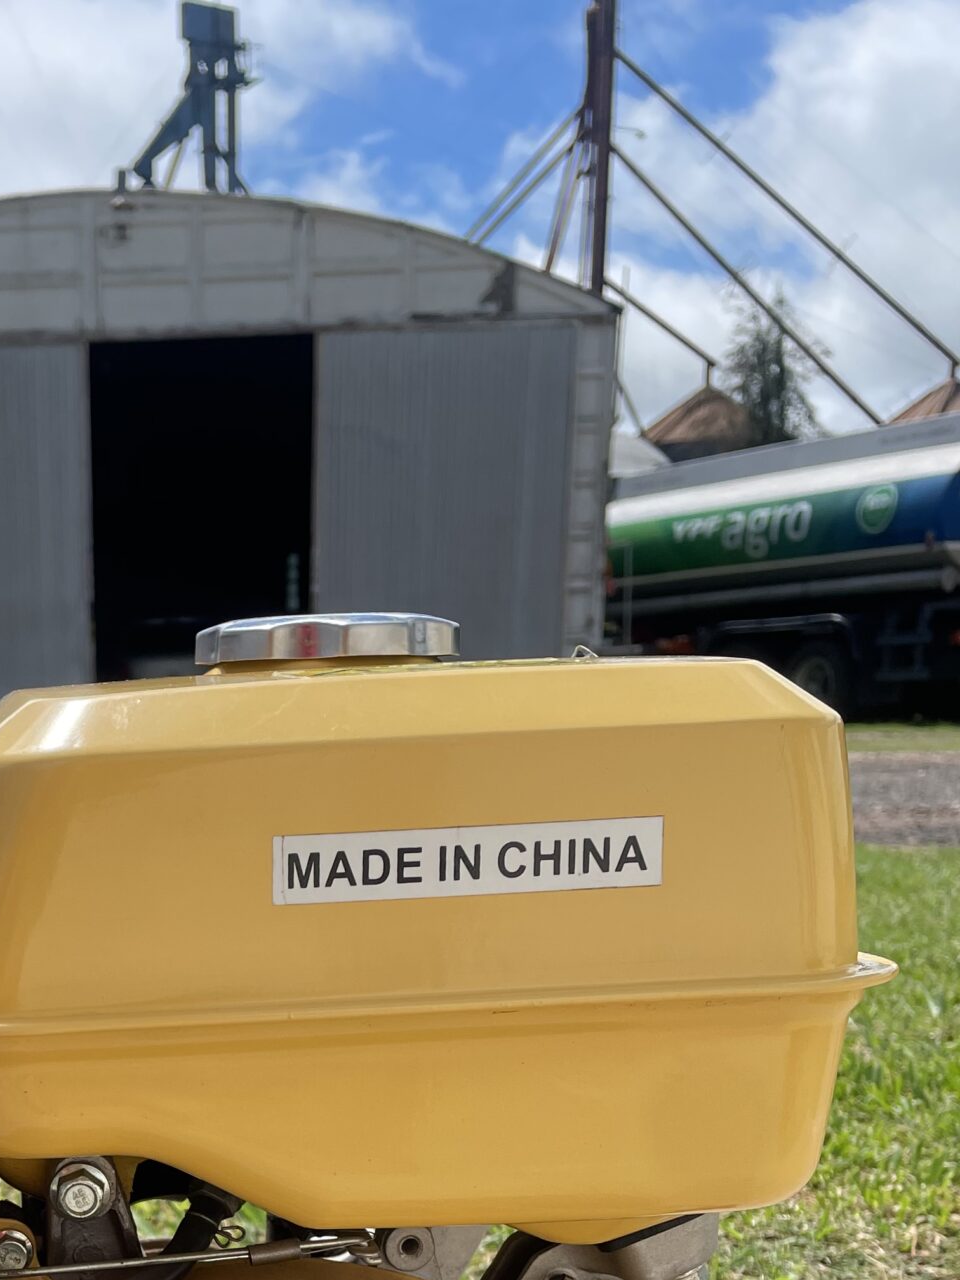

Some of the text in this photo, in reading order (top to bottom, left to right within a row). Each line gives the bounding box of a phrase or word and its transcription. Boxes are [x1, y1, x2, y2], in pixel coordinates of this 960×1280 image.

[721, 500, 813, 558] agro
[287, 835, 648, 890] MADE IN CHINA
